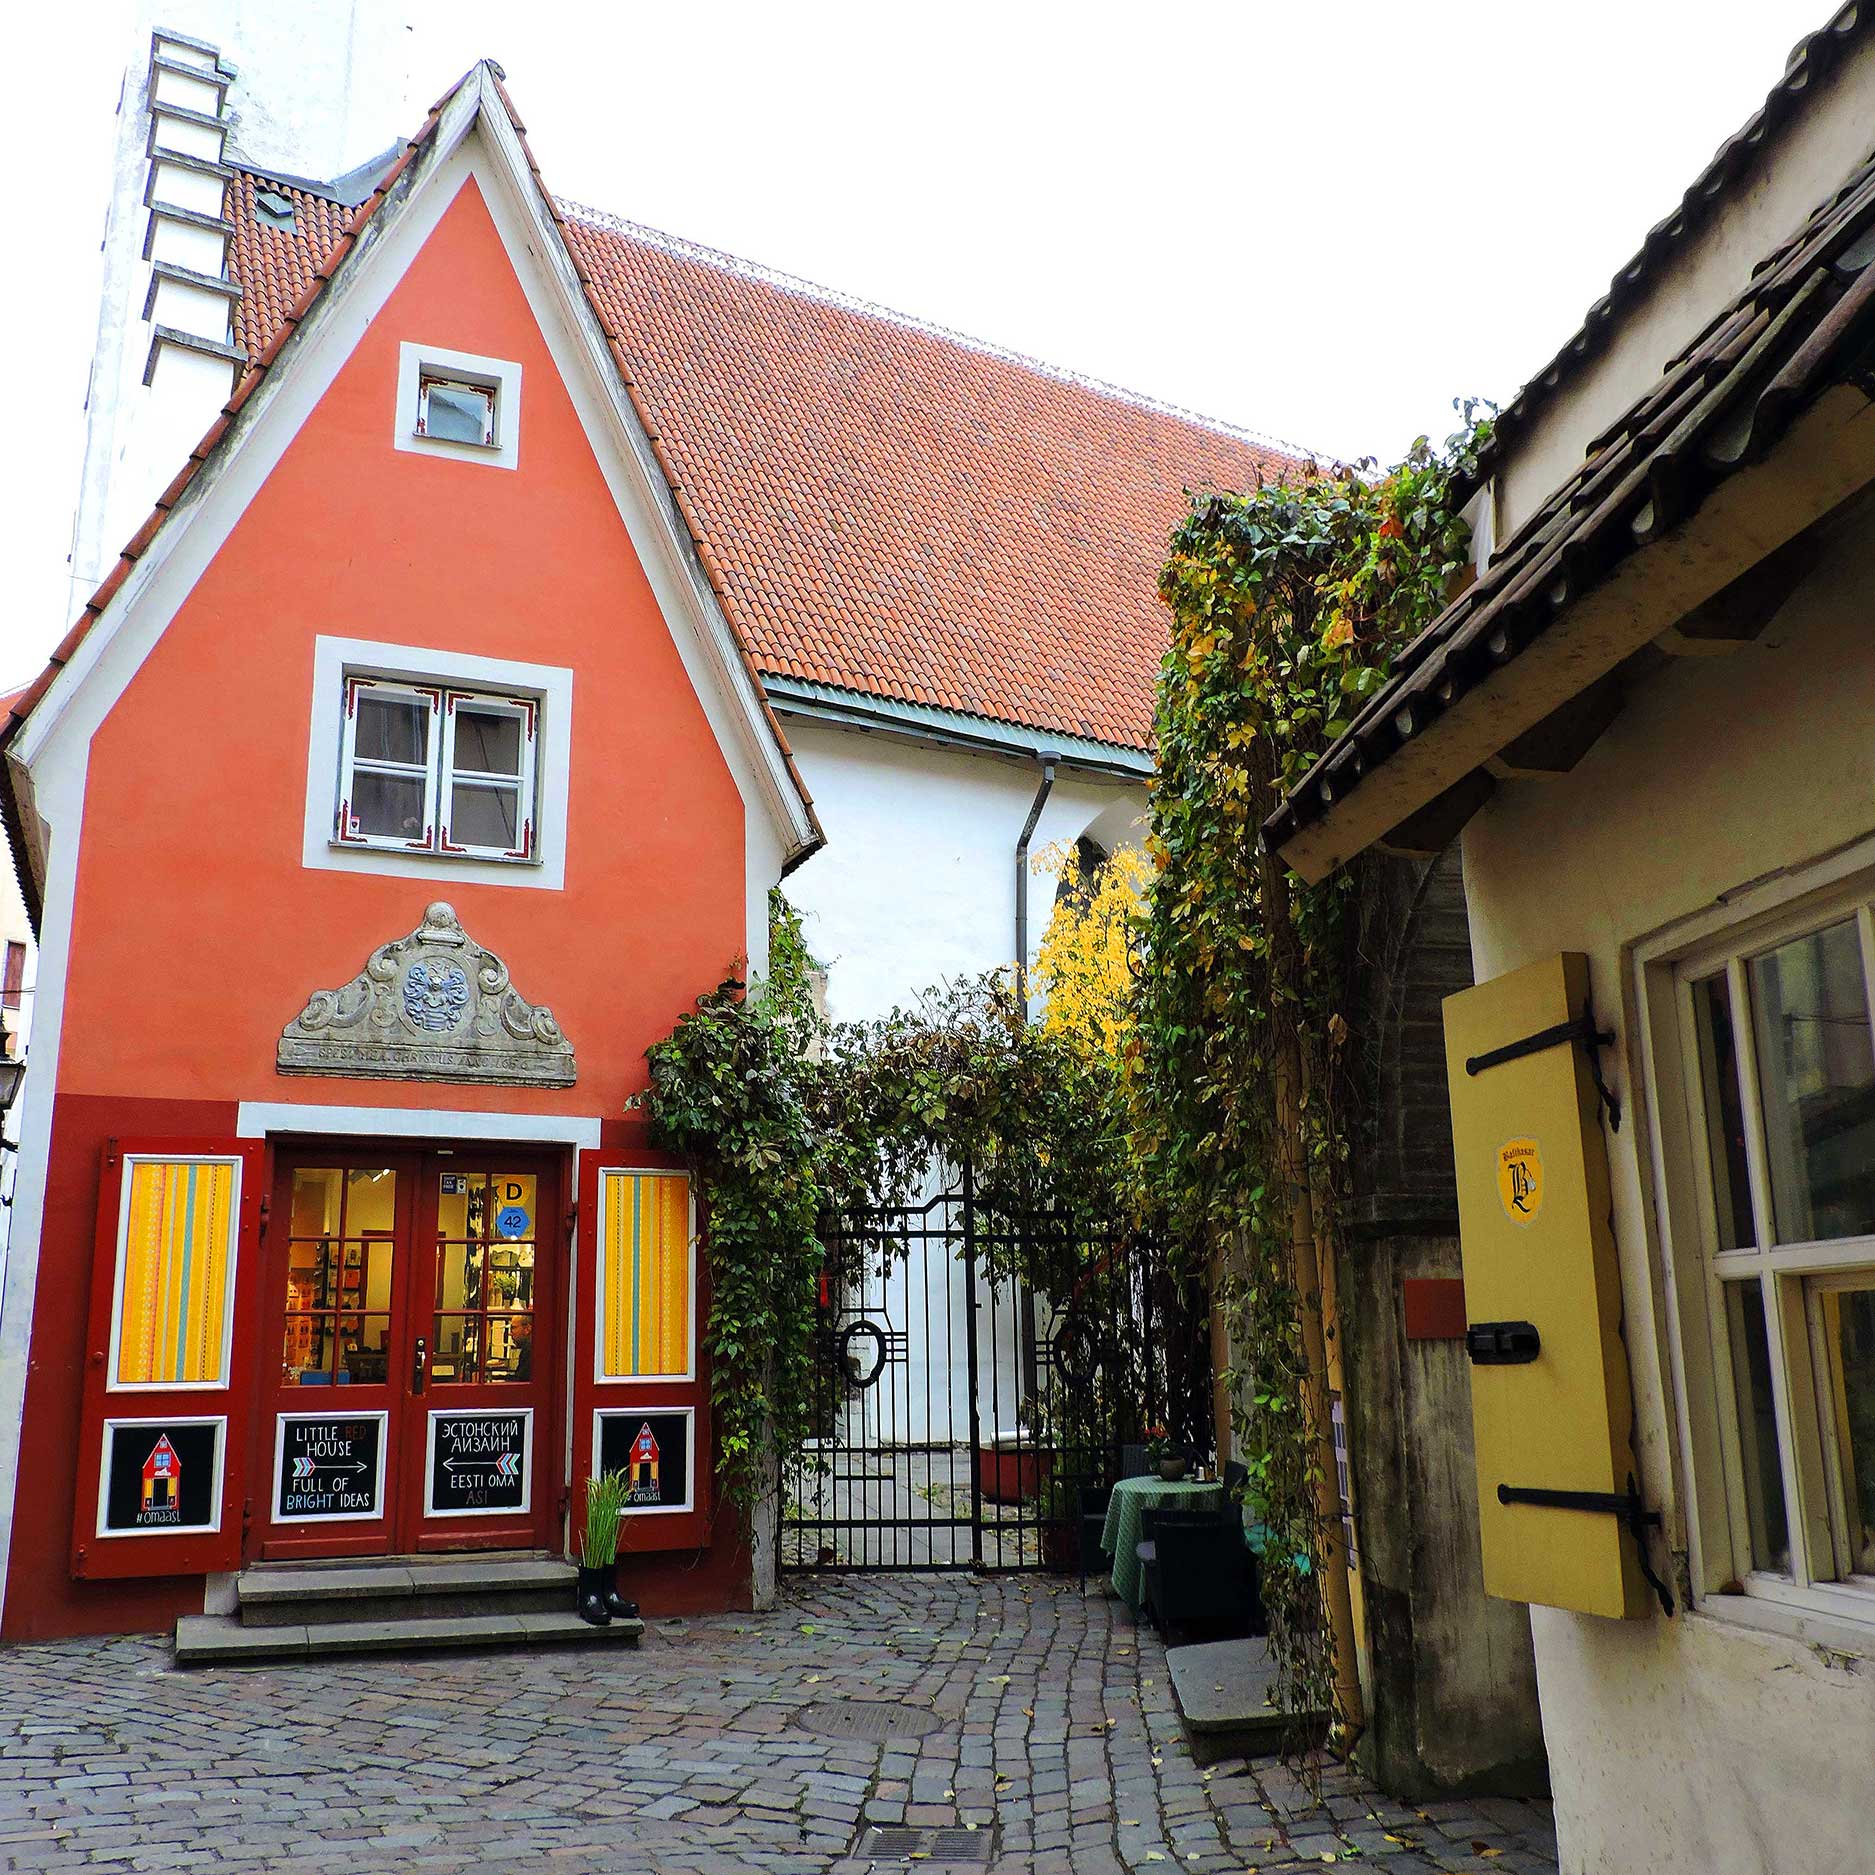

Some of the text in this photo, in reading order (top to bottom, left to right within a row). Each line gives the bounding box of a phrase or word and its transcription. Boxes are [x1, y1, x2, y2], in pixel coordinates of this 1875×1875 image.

[506, 1183, 522, 1200] D
[504, 1215, 521, 1228] 42
[296, 1425, 366, 1441] LITTLE RED
[442, 1420, 518, 1438] ЭСТОНСКИЙ
[307, 1441, 352, 1456] HOUSE
[292, 1477, 349, 1493] FULL OF
[450, 1474, 515, 1489] EESTI OMA
[286, 1493, 370, 1510] BRIGHT IDEAS
[466, 1490, 488, 1504] ASI
